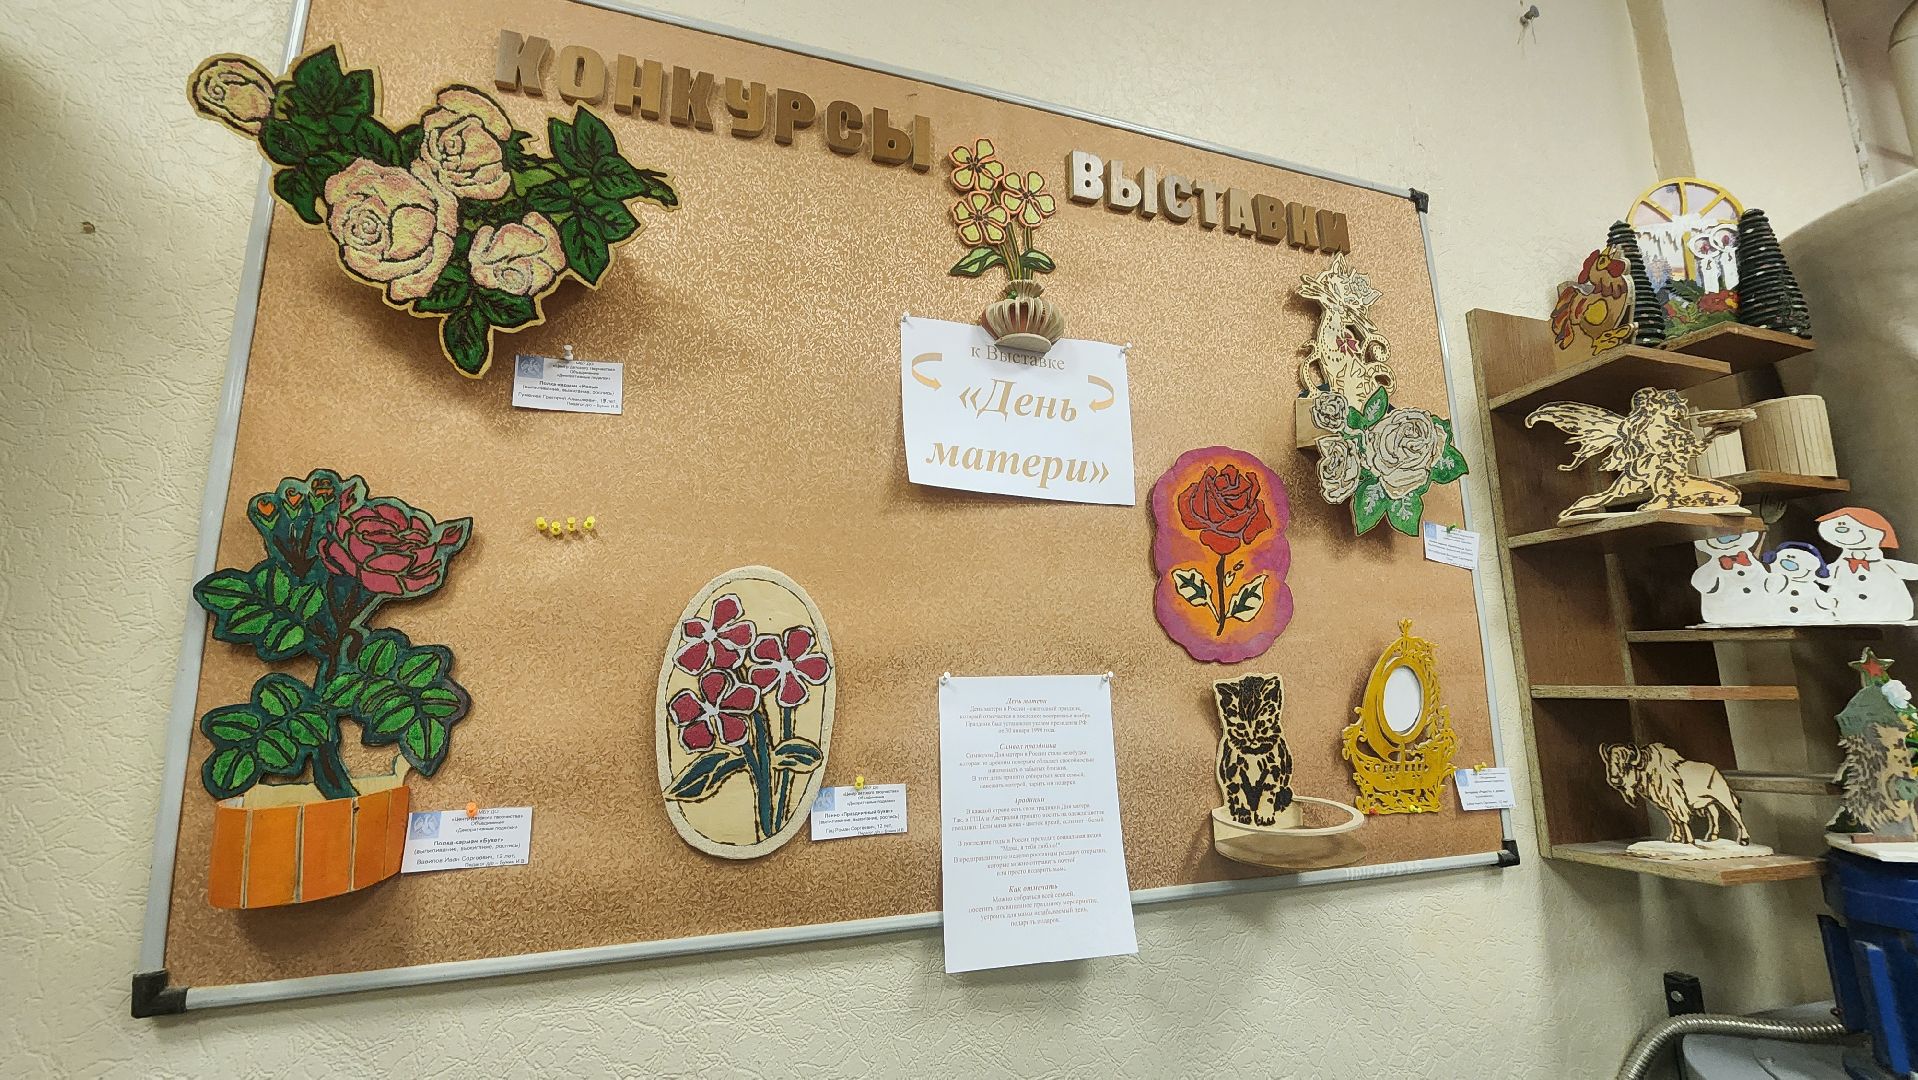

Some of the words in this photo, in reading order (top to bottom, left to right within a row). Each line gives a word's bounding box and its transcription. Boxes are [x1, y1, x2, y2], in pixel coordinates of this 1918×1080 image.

[494, 28, 932, 172] КОНКУРСЫ
[1068, 148, 1351, 254] ВЫСТАВКИ
[971, 346, 980, 357] к
[986, 345, 1065, 370] Выставке
[959, 378, 1077, 423] «День
[925, 442, 1110, 489] матери»
